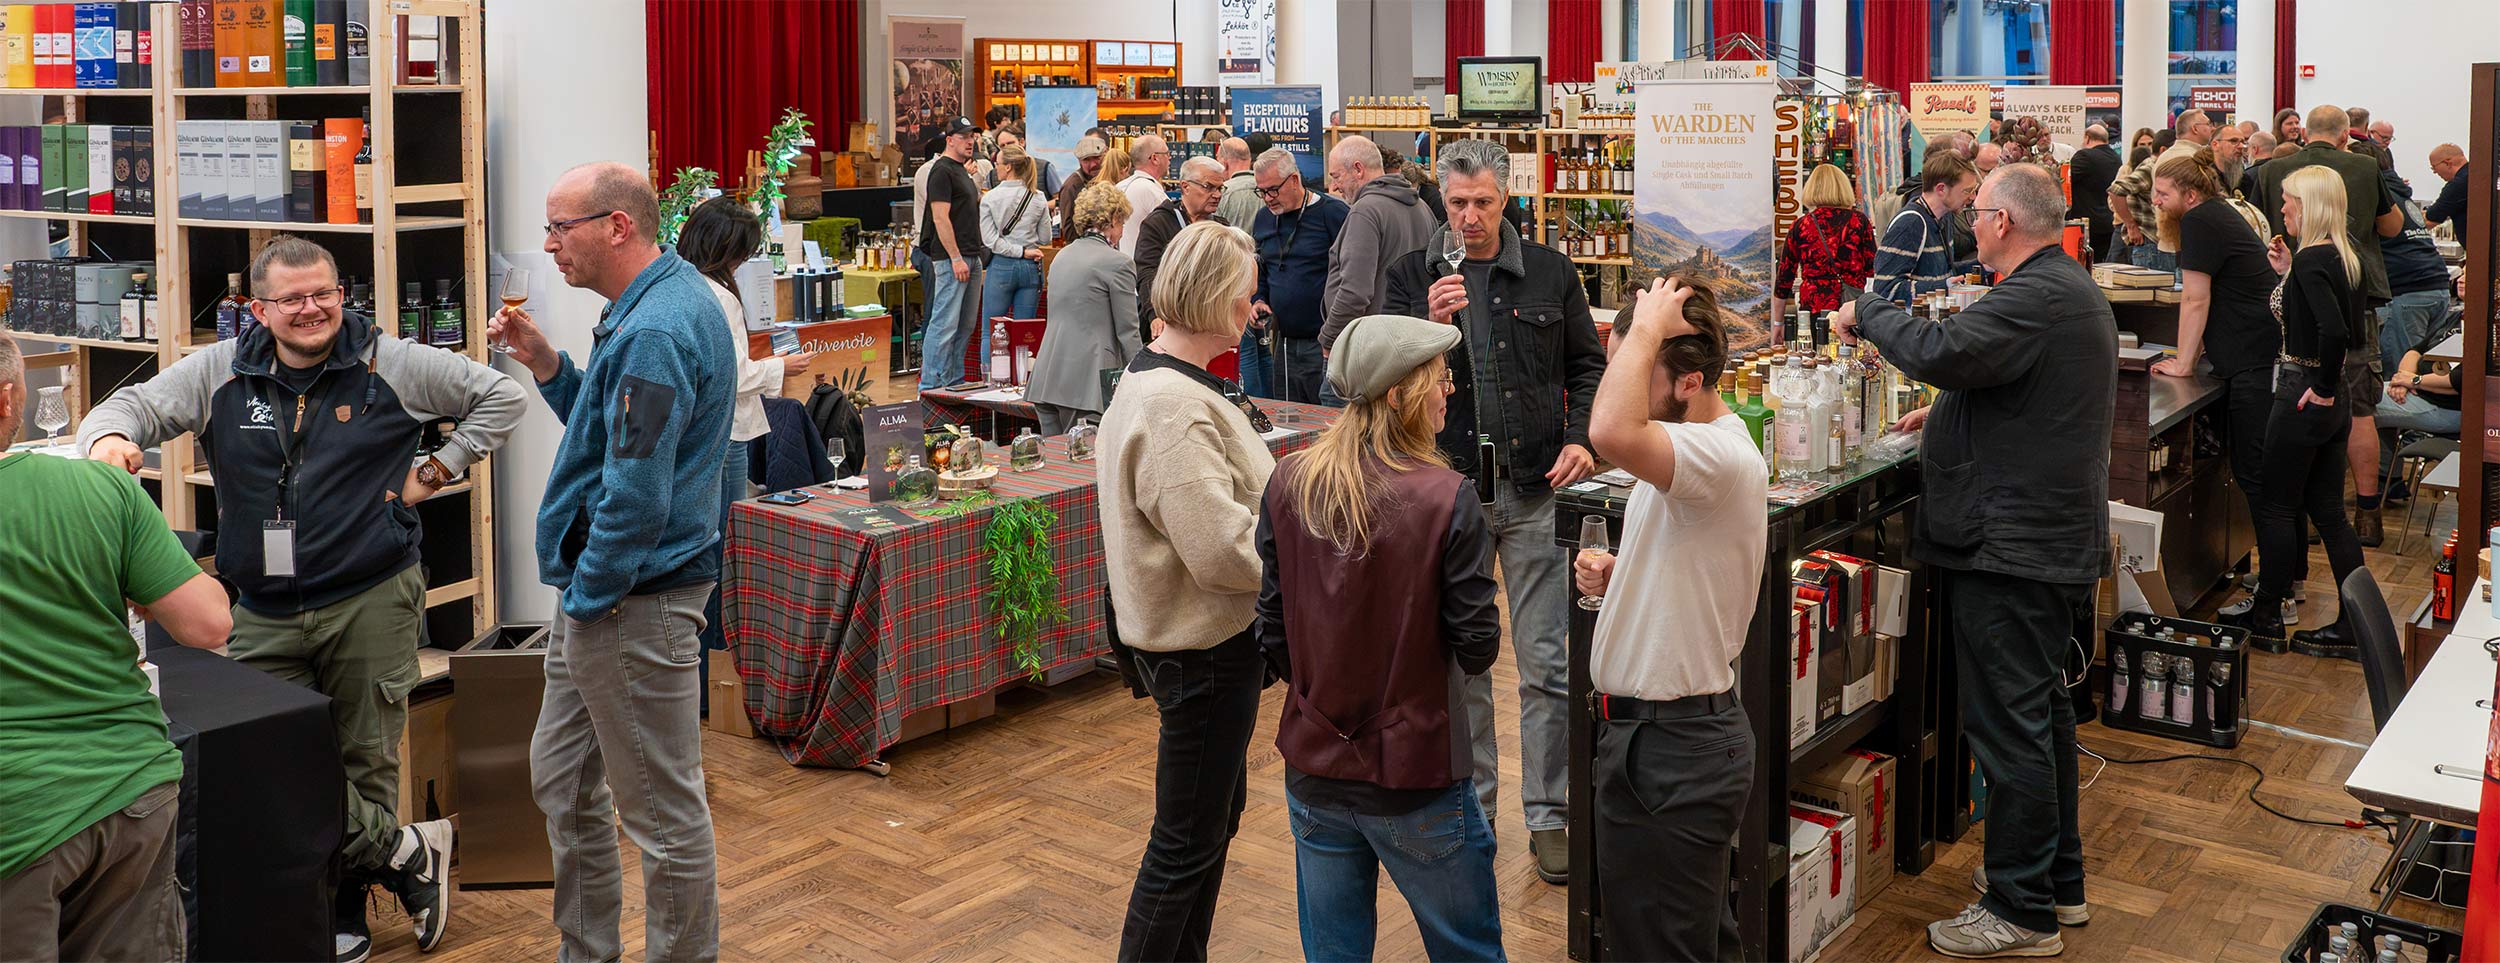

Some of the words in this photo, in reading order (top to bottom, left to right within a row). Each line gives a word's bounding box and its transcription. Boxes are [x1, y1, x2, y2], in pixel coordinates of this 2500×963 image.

[2086, 95, 2118, 104] OTMAN
[2194, 91, 2236, 101] SCHOT
[1243, 104, 1309, 116] EXCEPTIONAL
[1693, 103, 1713, 111] THE
[2005, 104, 2050, 113] ALWAYS
[2054, 104, 2083, 113] KEEP
[1651, 114, 1756, 133] WARDEN
[2041, 115, 2071, 124] PARK
[1244, 117, 1309, 133] FLAVOURS
[2050, 126, 2075, 135] EACH.
[1660, 136, 1673, 145] OF
[1675, 136, 1695, 145] THE
[1697, 136, 1746, 145] MARCHES
[1288, 143, 1310, 152] STILLS
[1661, 160, 1706, 170] Unabhängig
[1706, 160, 1743, 170] abgefüllte
[1652, 171, 1674, 180] Single
[1675, 171, 1691, 180] Cask
[1693, 171, 1709, 180] und
[1710, 171, 1730, 180] Small
[1731, 171, 1753, 180] Batch
[1774, 105, 1800, 256] SHEBE
[1680, 181, 1725, 191] Abfüllungen
[801, 332, 876, 355] Olivenöle
[879, 414, 907, 426] ALMA
[935, 440, 951, 448] ALMA
